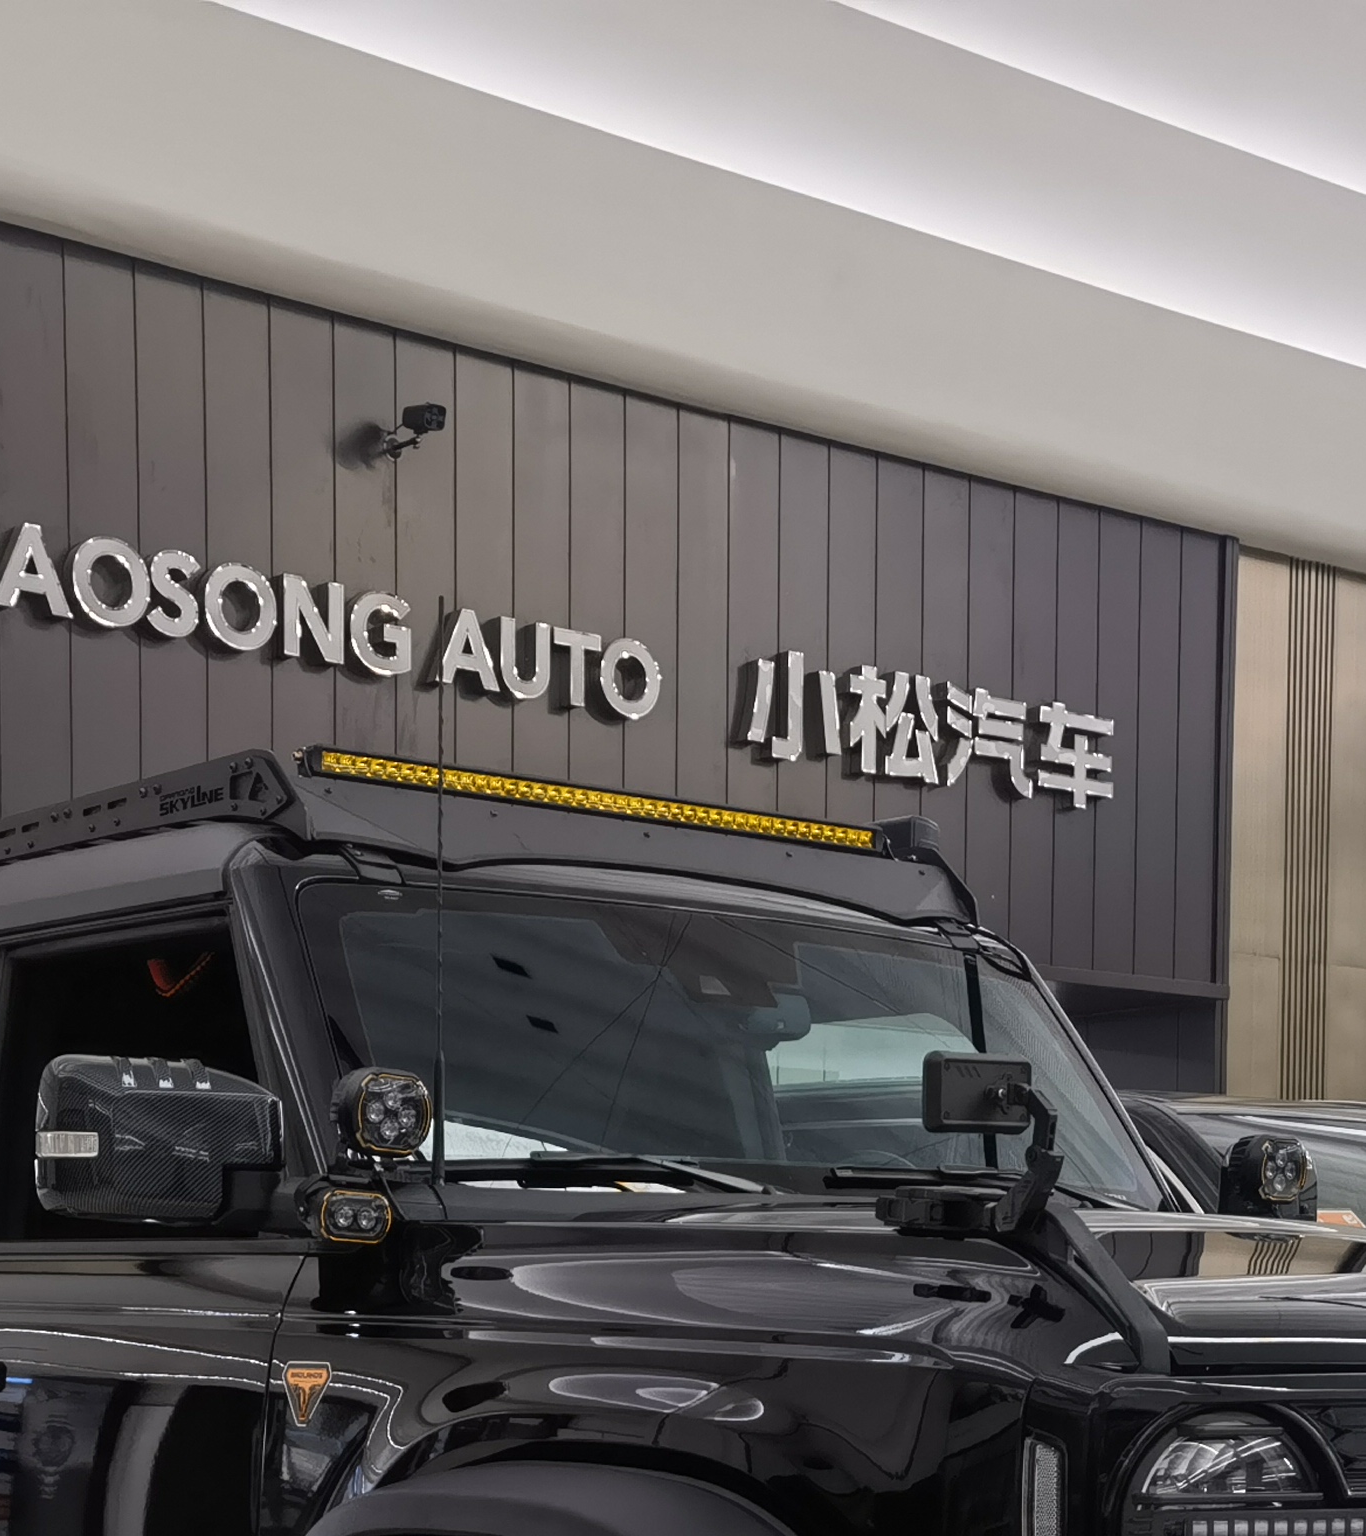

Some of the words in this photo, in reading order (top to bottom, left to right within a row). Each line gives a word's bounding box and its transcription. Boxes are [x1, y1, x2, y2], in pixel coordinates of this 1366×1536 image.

[439, 606, 662, 721] AUTO
[741, 650, 1115, 809] 小松汽车
[160, 785, 224, 817] SKYLINE
